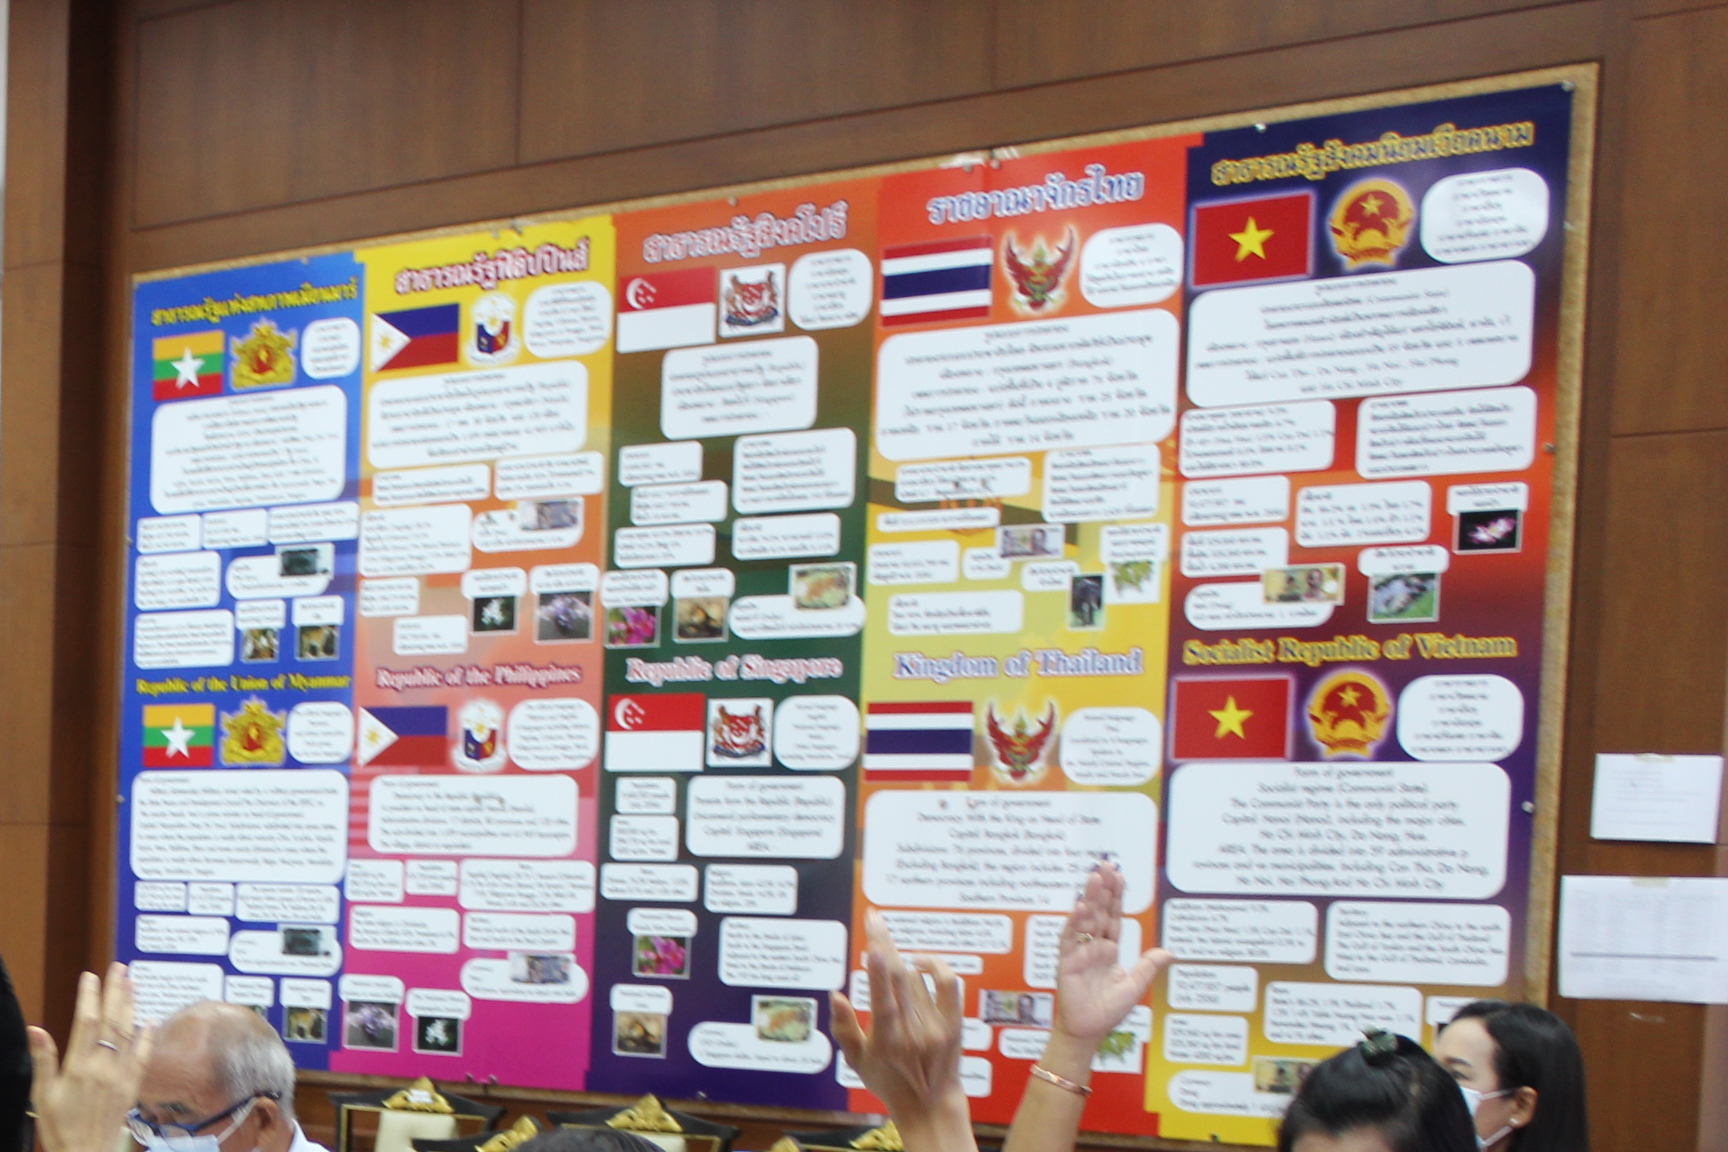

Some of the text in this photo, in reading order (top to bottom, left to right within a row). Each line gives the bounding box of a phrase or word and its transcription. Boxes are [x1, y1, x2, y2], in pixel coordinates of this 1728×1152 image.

[927, 163, 1145, 225] ราชอาณาจักรไทย
[643, 199, 849, 263] สาธารณรัฐสิงคโปร์
[892, 646, 1144, 685] Kingdom of Thailand
[1182, 632, 1518, 667] Socialist Republic of Vietnam
[135, 672, 353, 698] Republic of the Union of Myanmar
[375, 662, 583, 692] Republic of the Philippines
[625, 653, 844, 688] Republic of Singapore
